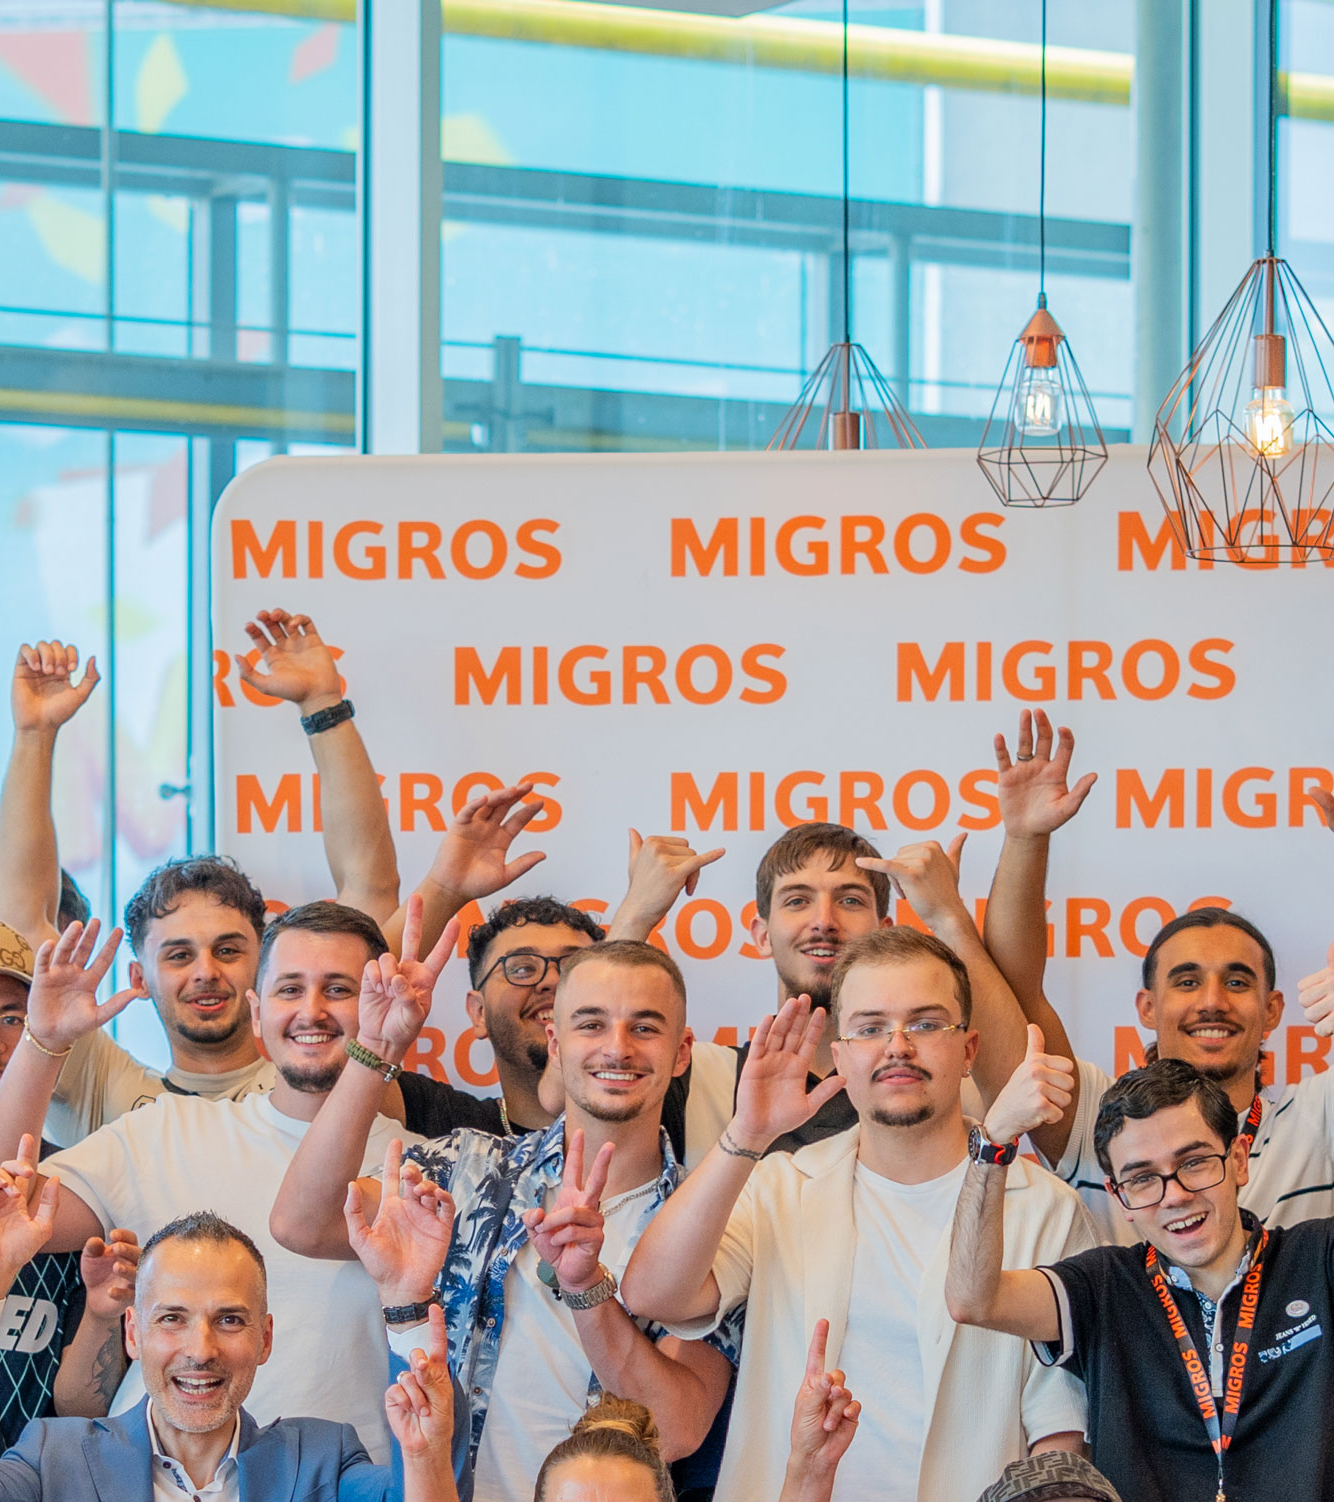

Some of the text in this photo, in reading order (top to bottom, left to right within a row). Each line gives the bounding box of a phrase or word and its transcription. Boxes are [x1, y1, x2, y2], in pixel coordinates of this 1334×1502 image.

[231, 519, 563, 580] MIGROS
[670, 513, 1007, 577] MIGROS
[454, 643, 787, 706] MIGROS
[897, 638, 1237, 702] MIGROS
[236, 772, 563, 834] MIROS
[671, 770, 1003, 831] MIGROS
[1238, 1263, 1263, 1329] MIGROS
[1182, 1348, 1216, 1419] MIGROS
[1224, 1341, 1249, 1415] MIGROS
